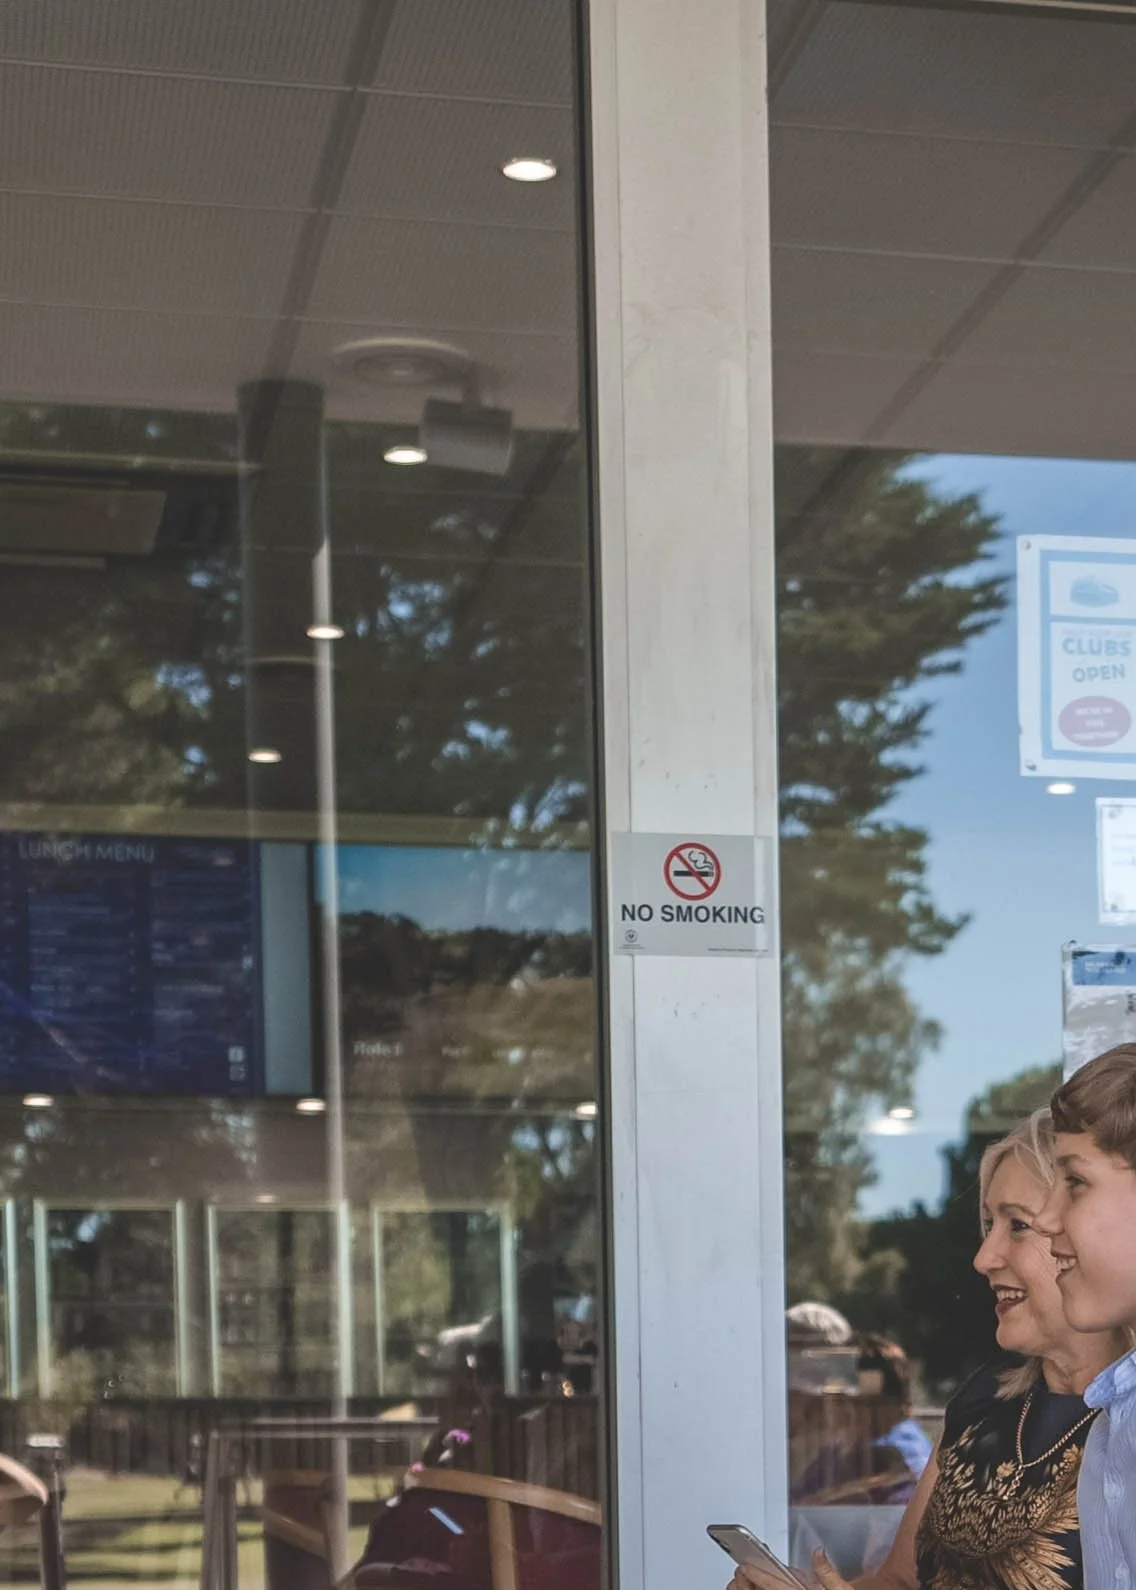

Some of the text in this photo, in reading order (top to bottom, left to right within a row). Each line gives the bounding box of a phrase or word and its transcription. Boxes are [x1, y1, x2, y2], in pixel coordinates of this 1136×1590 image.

[1062, 637, 1132, 657] CLUBS
[1072, 664, 1126, 683] OPEN
[19, 840, 89, 862] LUNCH
[96, 843, 155, 863] MENU
[621, 904, 765, 924] NO SMOKING
